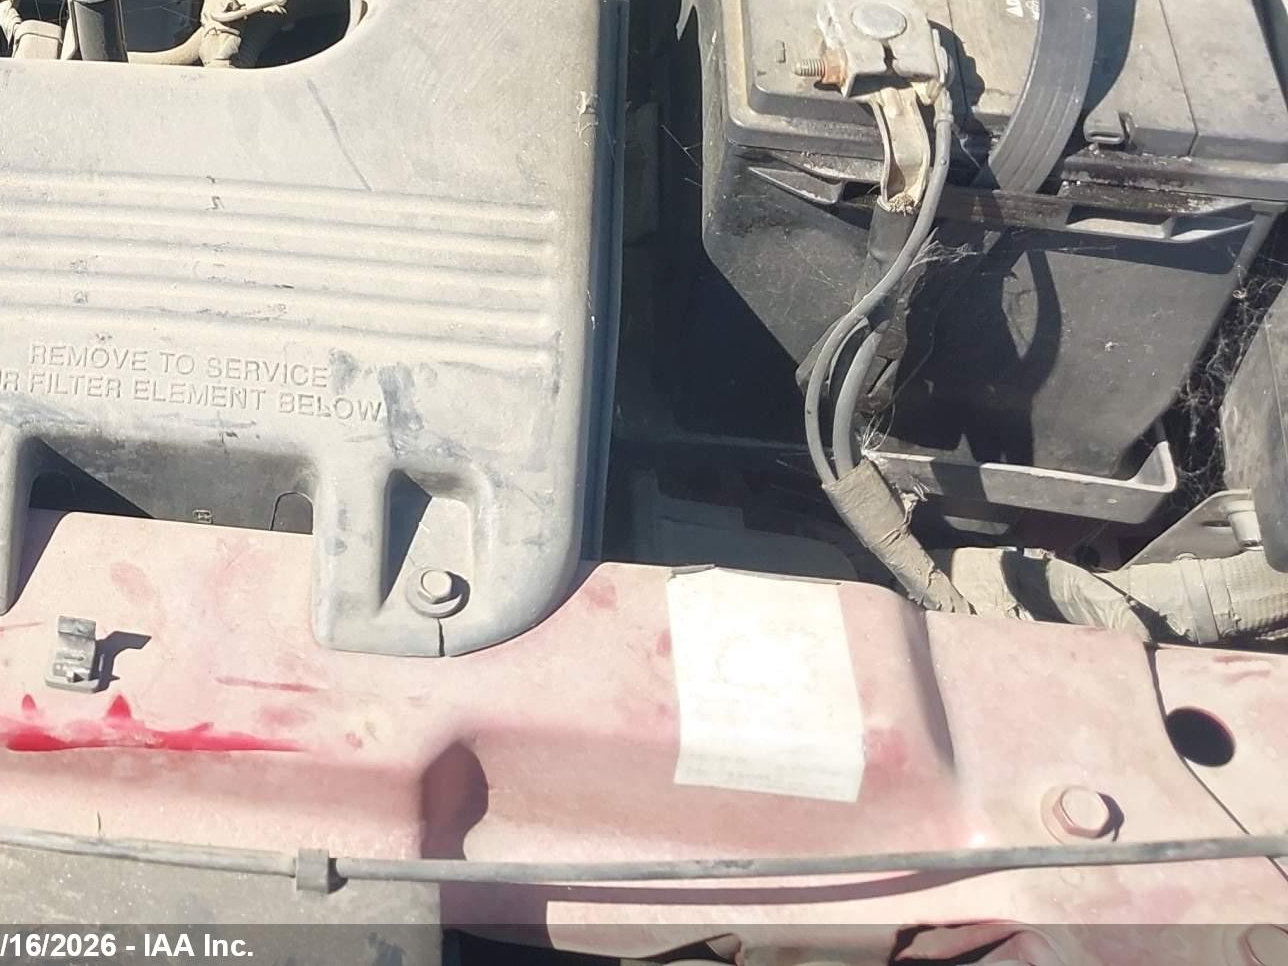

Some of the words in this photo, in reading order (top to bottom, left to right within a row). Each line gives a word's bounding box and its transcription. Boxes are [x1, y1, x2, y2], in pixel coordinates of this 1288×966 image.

[29, 343, 149, 372] REMOVE
[159, 351, 196, 376] TO
[206, 355, 329, 389] SERVICE
[28, 372, 123, 399] FILTER
[132, 379, 267, 411] ELEMENT
[277, 392, 383, 424] BELOW
